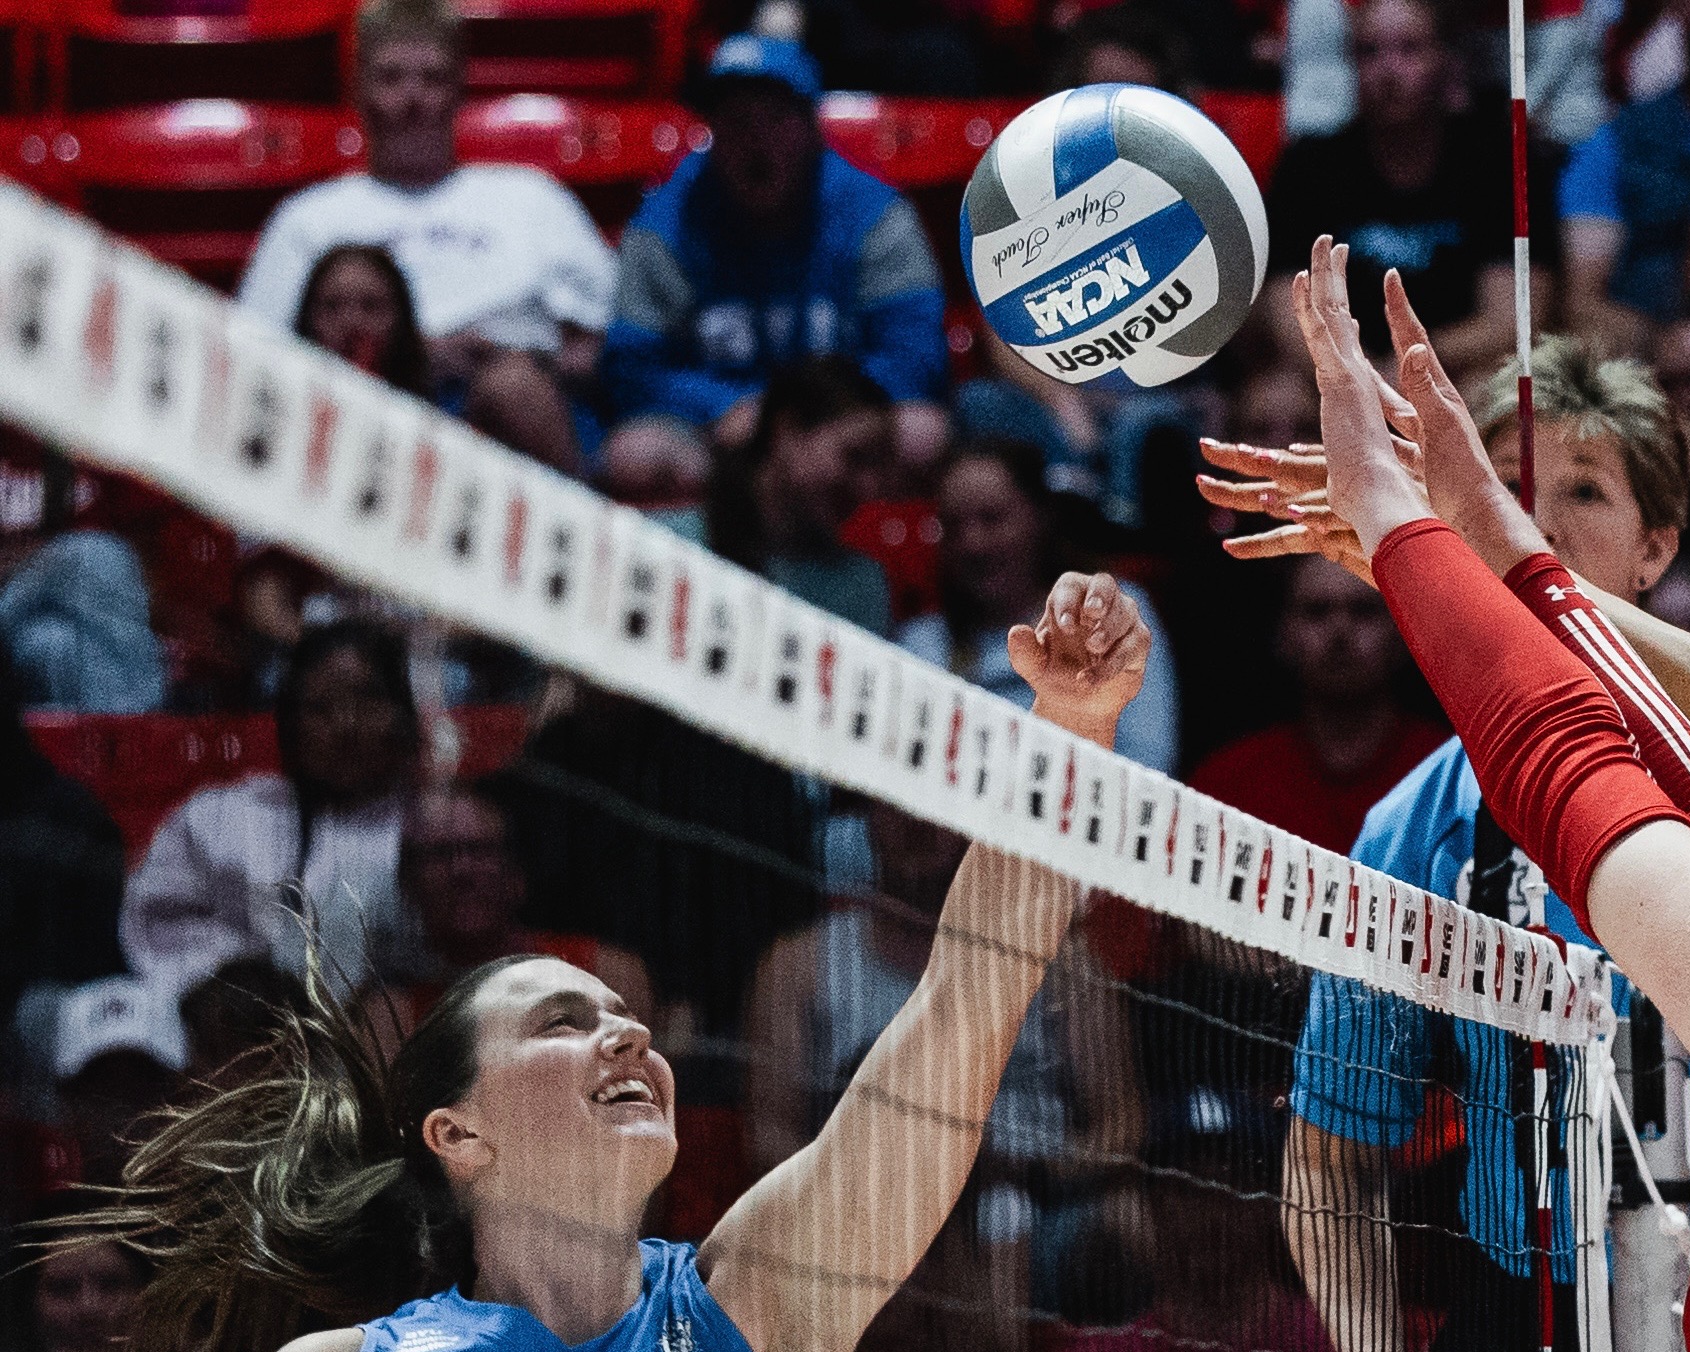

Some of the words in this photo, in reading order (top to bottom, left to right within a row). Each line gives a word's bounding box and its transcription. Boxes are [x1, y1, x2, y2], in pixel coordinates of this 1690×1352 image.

[1055, 190, 1126, 230] Super
[991, 226, 1050, 279] Touch
[1069, 264, 1089, 281] NCAA
[1023, 243, 1151, 337] NCAA
[1045, 278, 1193, 373] molten
